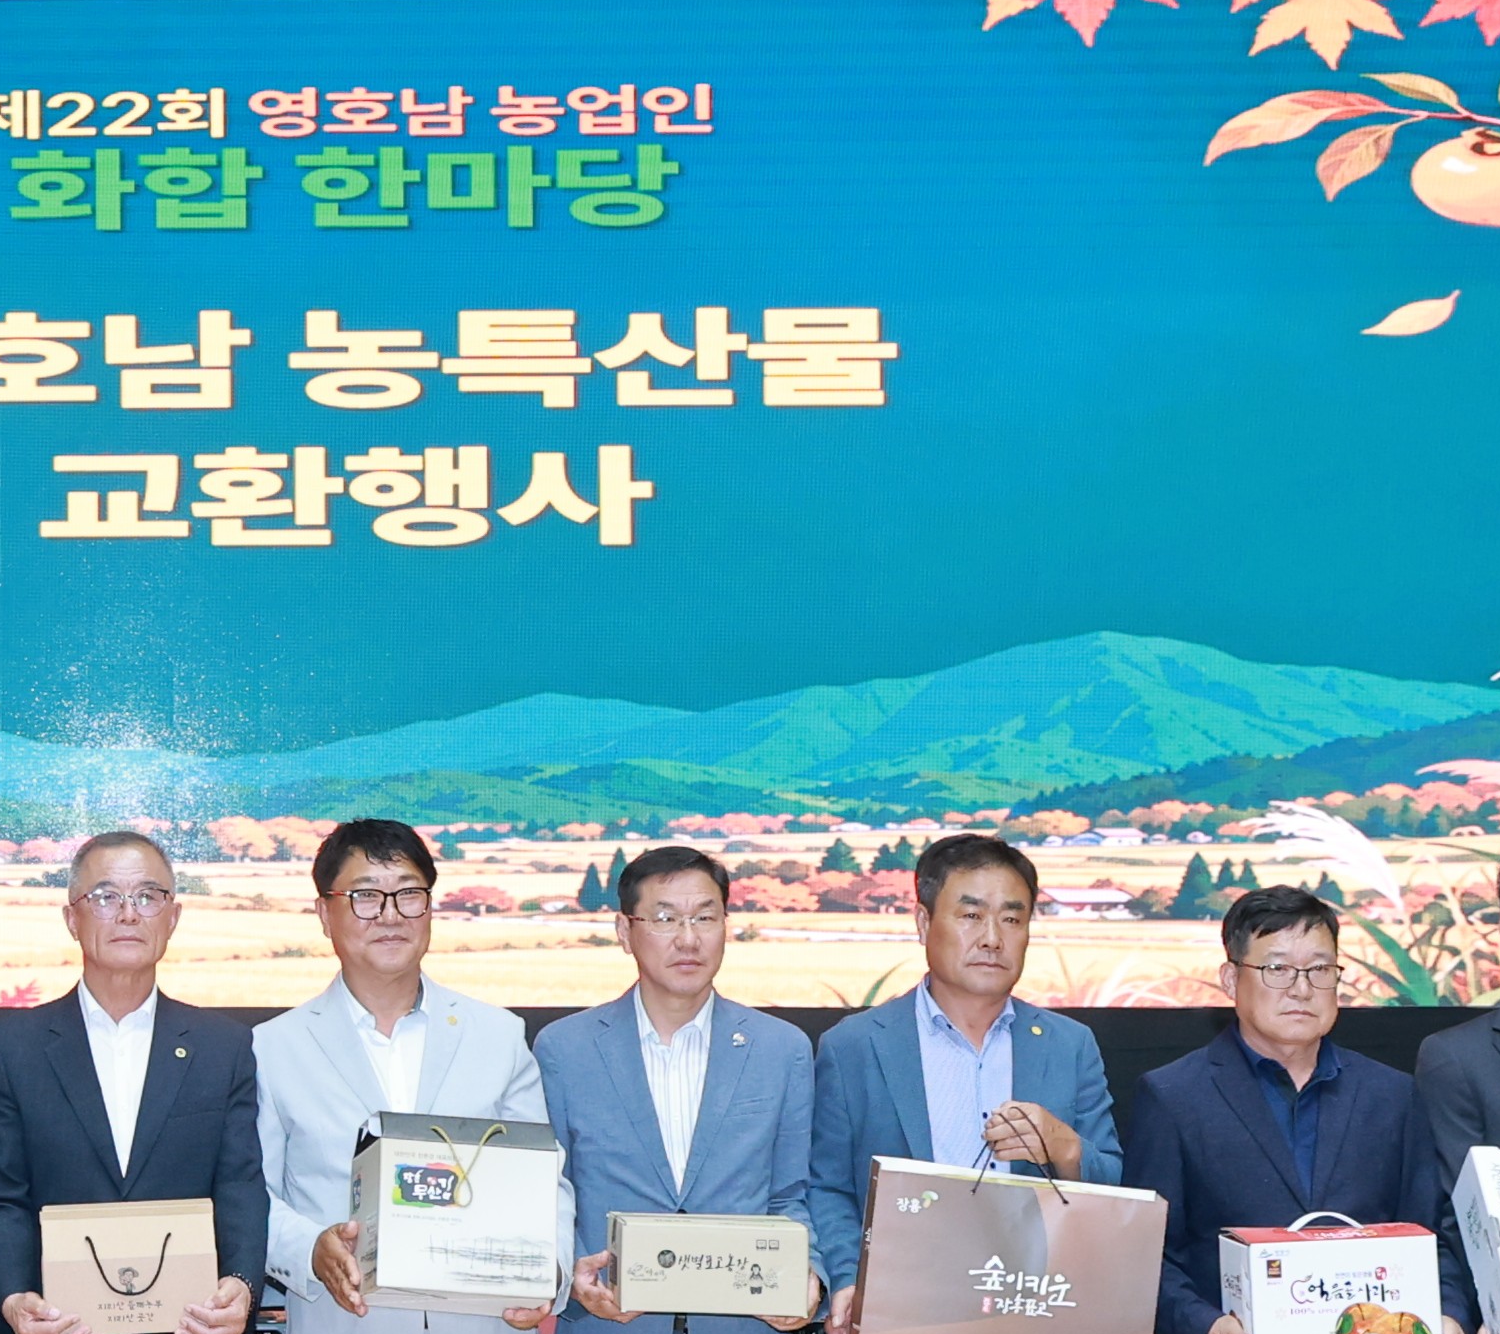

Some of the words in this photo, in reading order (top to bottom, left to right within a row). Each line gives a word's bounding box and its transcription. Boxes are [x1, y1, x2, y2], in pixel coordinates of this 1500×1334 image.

[247, 85, 473, 136] 영호남
[490, 83, 715, 135] 농업인
[9, 145, 264, 232] 화합
[294, 143, 681, 229] 한마당
[288, 306, 899, 410] 농특산물
[38, 445, 656, 547] 교환행사
